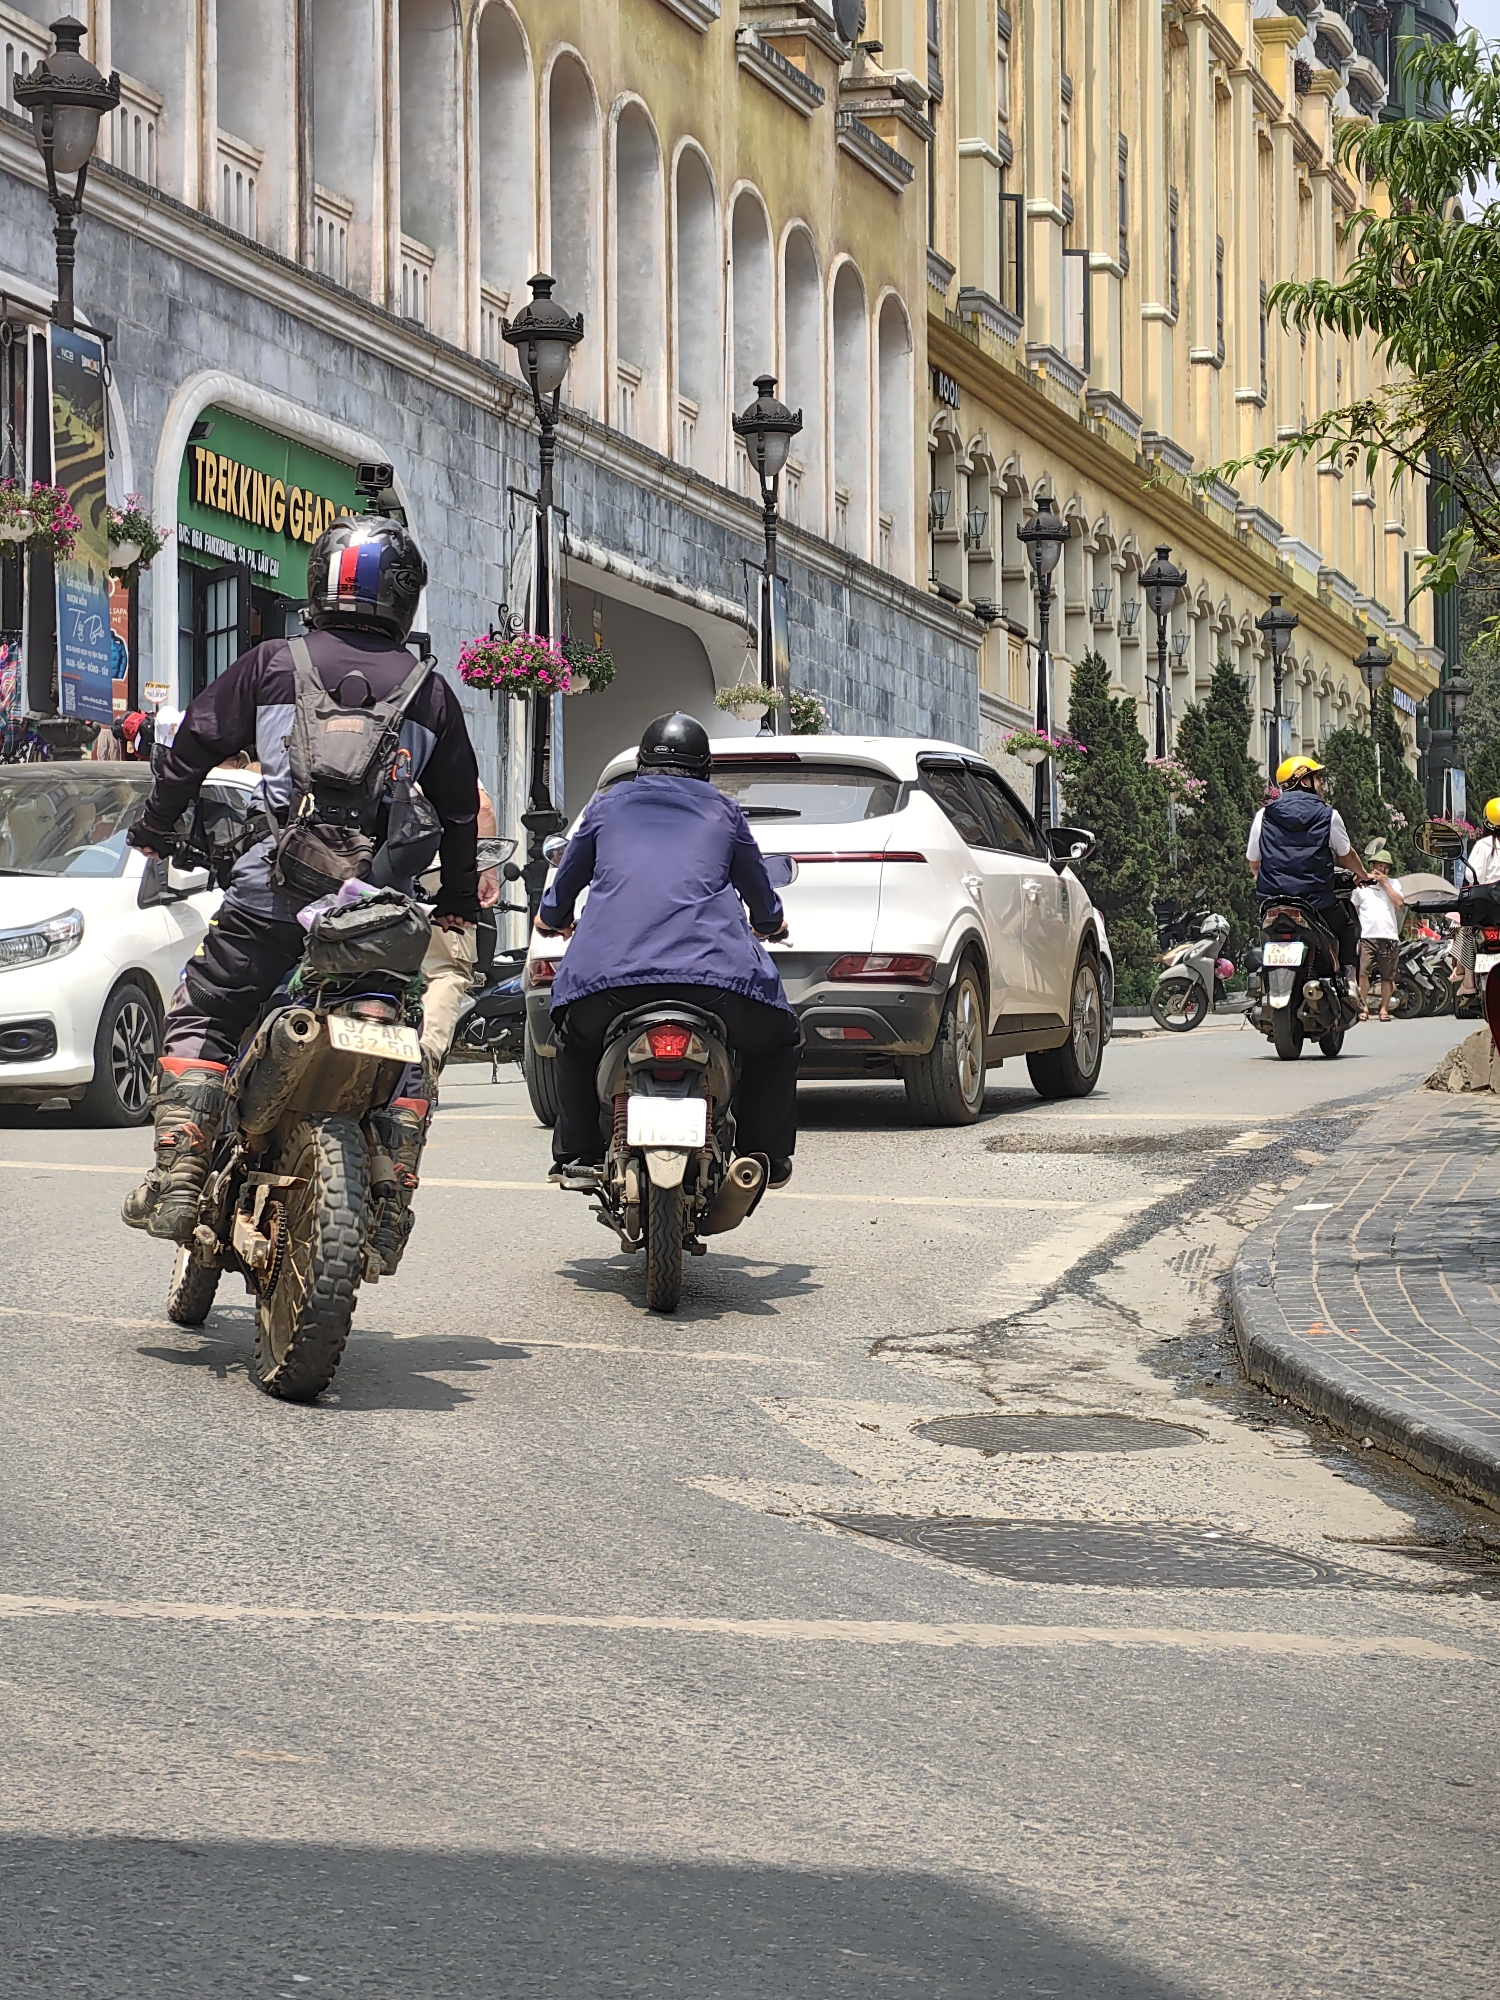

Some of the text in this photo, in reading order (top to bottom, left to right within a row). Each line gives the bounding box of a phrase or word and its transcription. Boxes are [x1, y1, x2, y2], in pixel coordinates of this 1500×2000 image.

[61, 347, 74, 361] NCB
[196, 445, 285, 533] TREKKING
[269, 558, 280, 579] CAI
